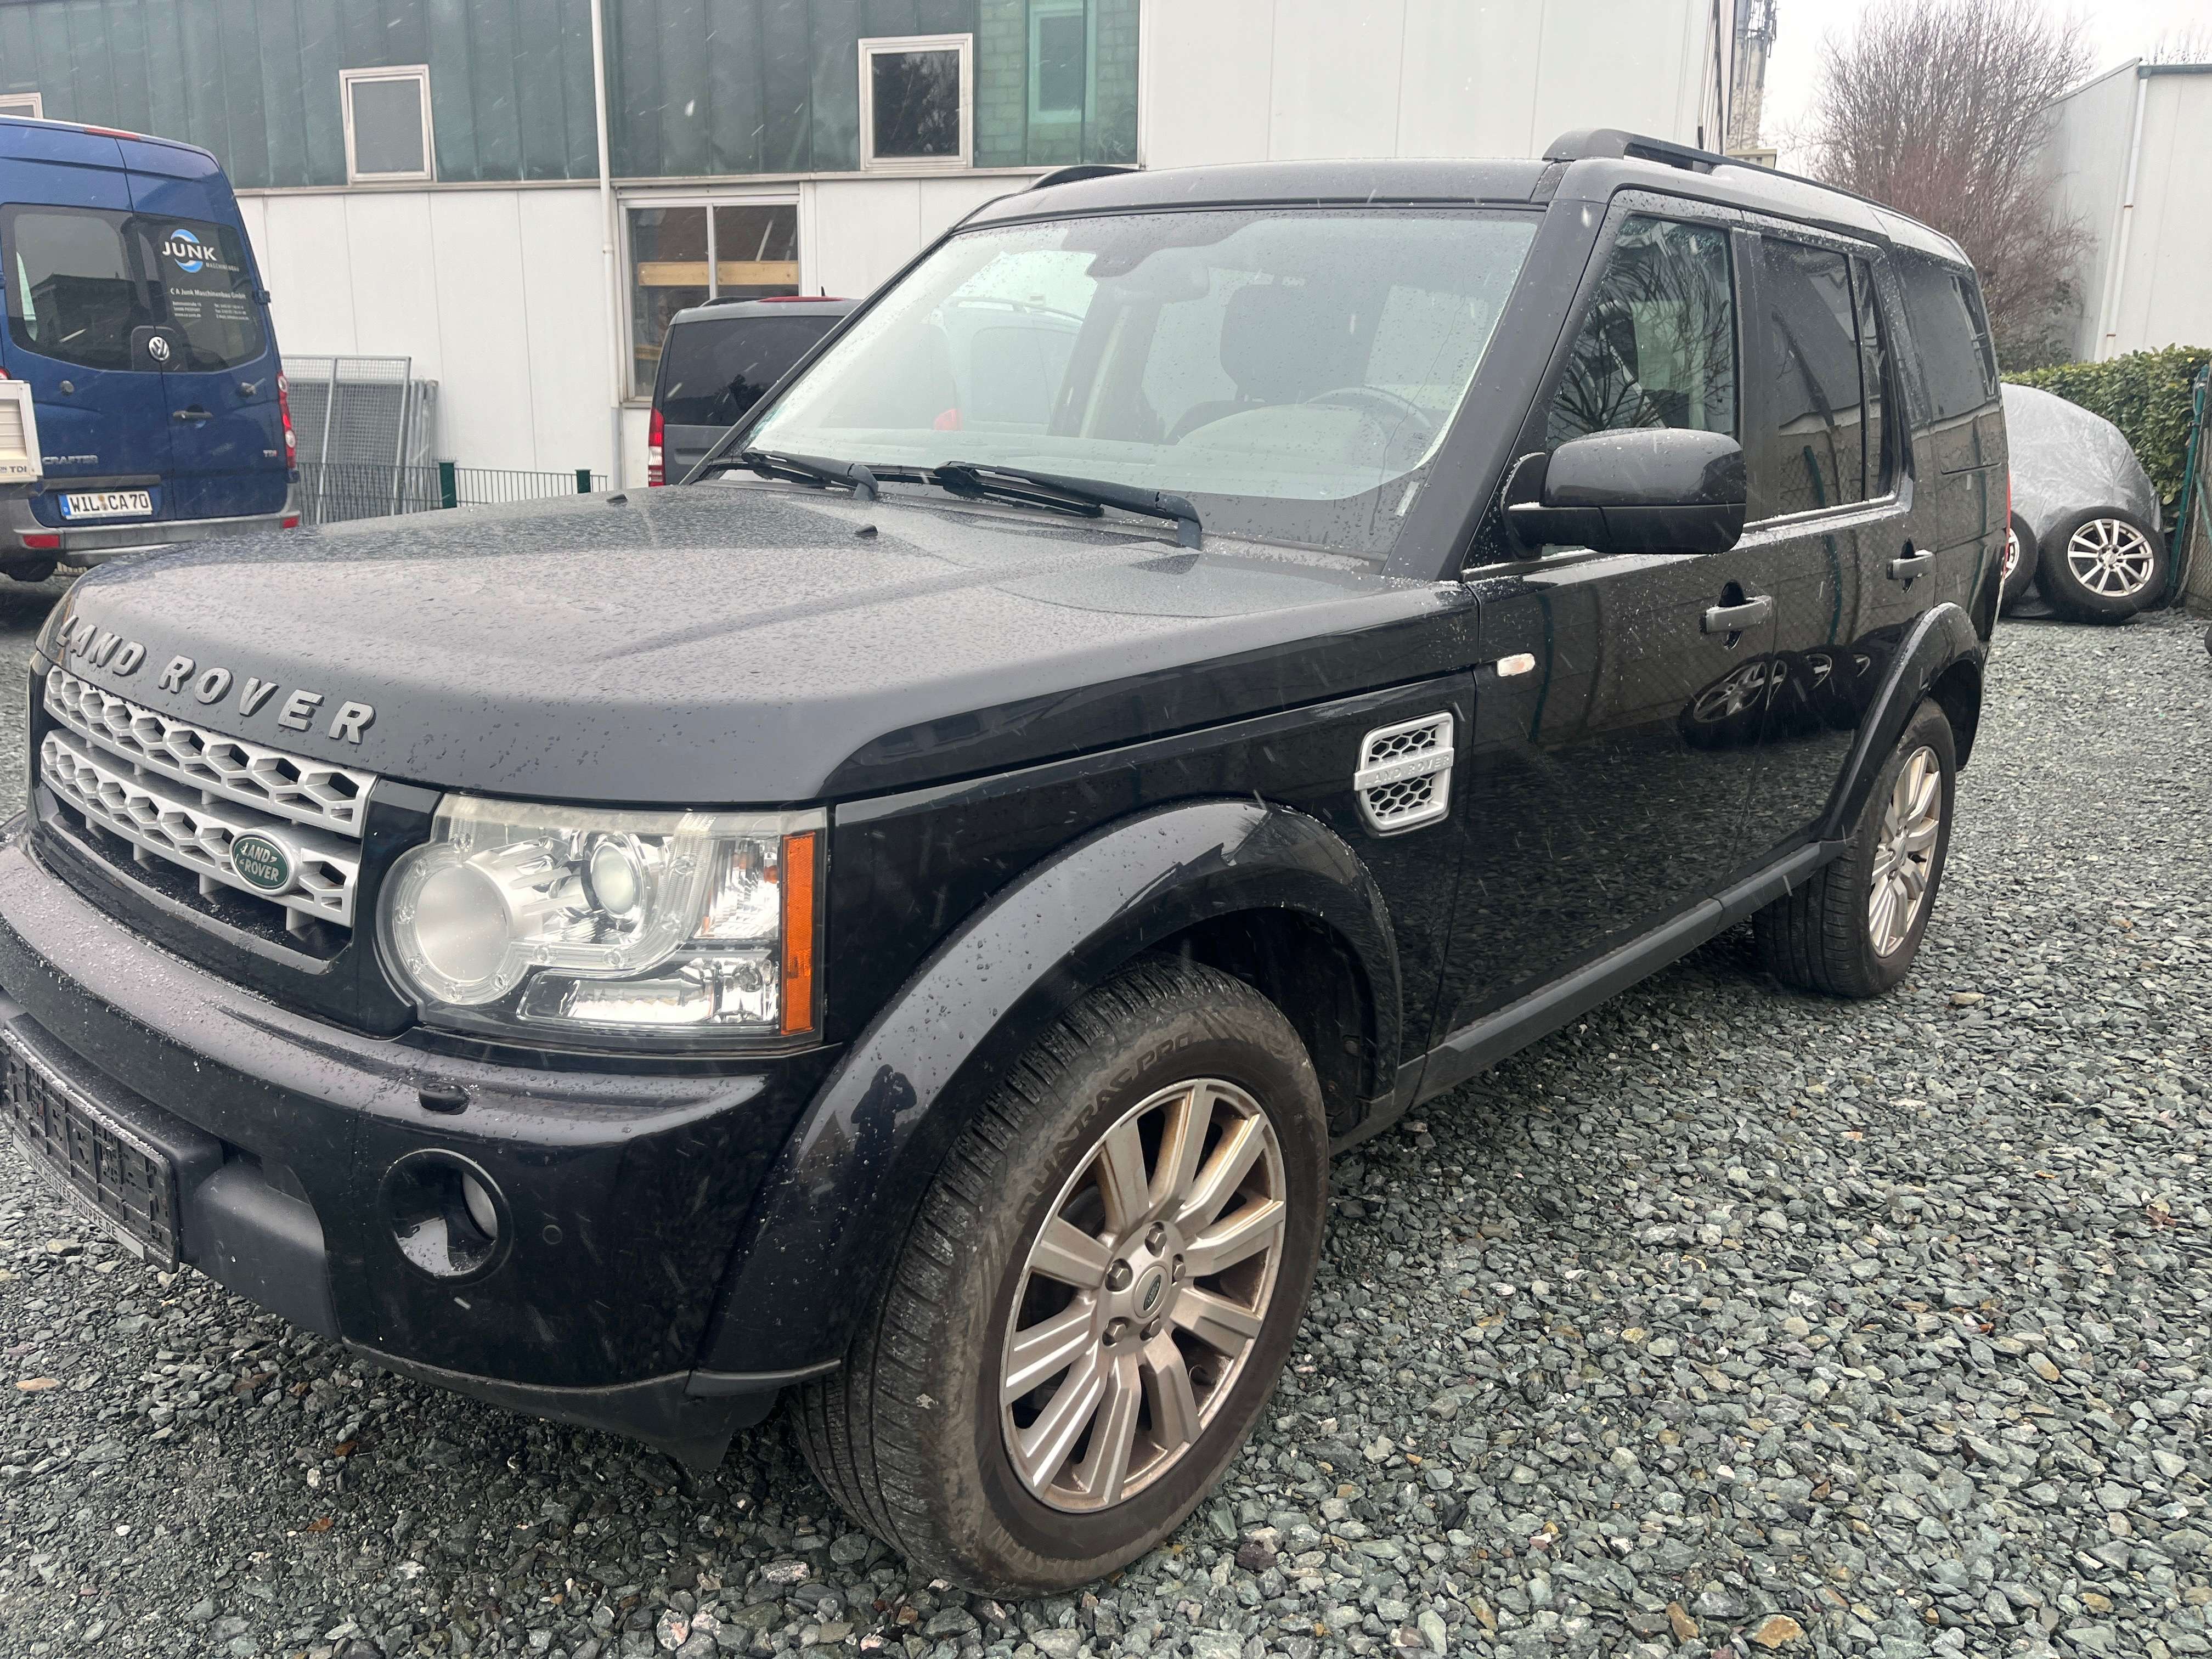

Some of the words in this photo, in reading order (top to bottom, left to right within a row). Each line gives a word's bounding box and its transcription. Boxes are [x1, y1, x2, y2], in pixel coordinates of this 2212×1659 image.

[162, 241, 217, 261] JUNK
[42, 455, 98, 465] CRAFTER
[70, 496, 100, 512] WIL
[108, 495, 128, 510] CA
[129, 494, 149, 509] 70
[55, 614, 145, 675] LAND
[159, 654, 375, 743] ROVER
[1365, 768, 1401, 786] LAND
[1408, 754, 1449, 775] ROVER
[240, 842, 270, 862] LAND
[244, 859, 279, 882] ROVER
[1137, 1031, 1193, 1074] PRO
[29, 1154, 117, 1238] WWW.HEISTER-GRUPPE.DE
